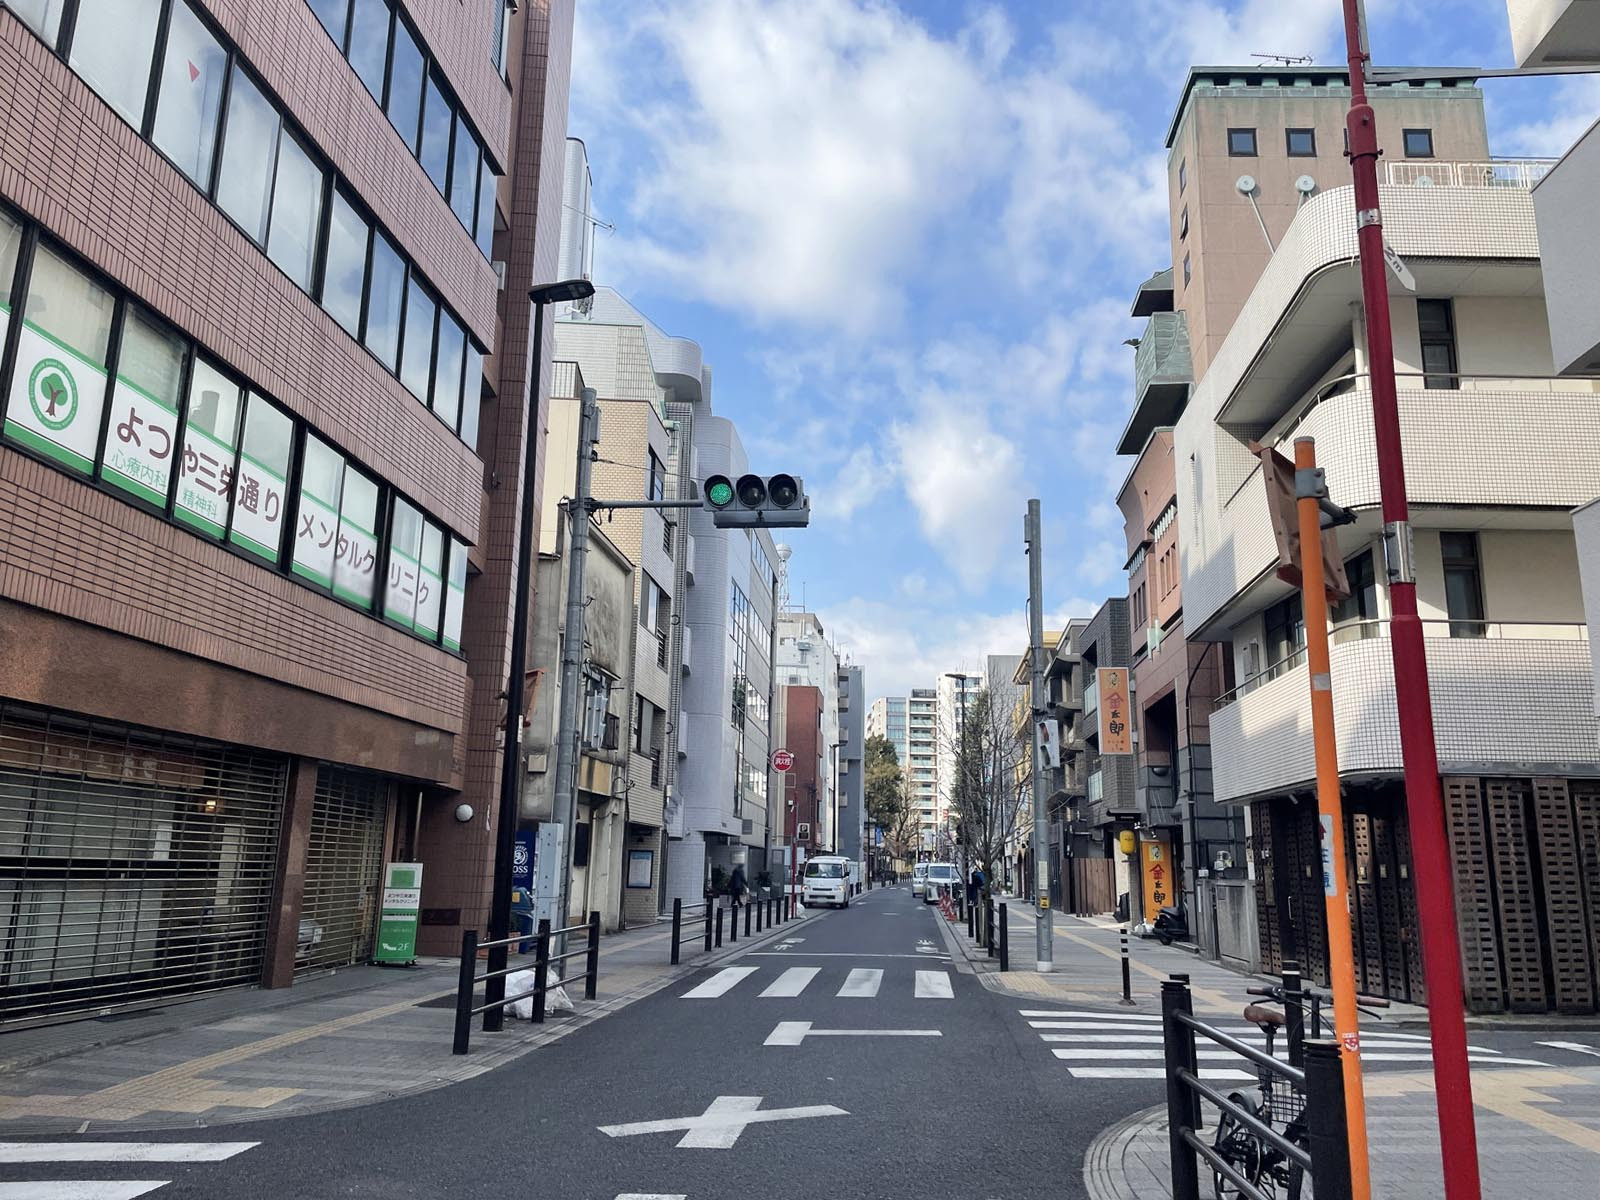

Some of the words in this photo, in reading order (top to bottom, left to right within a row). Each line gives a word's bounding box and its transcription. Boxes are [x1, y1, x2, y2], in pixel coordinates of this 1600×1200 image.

[111, 448, 167, 491] 心療内科
[182, 489, 217, 519] 精神科
[299, 513, 429, 604] メンタルクリニク
[512, 865, 529, 874] OSS
[397, 943, 410, 951] 2F
